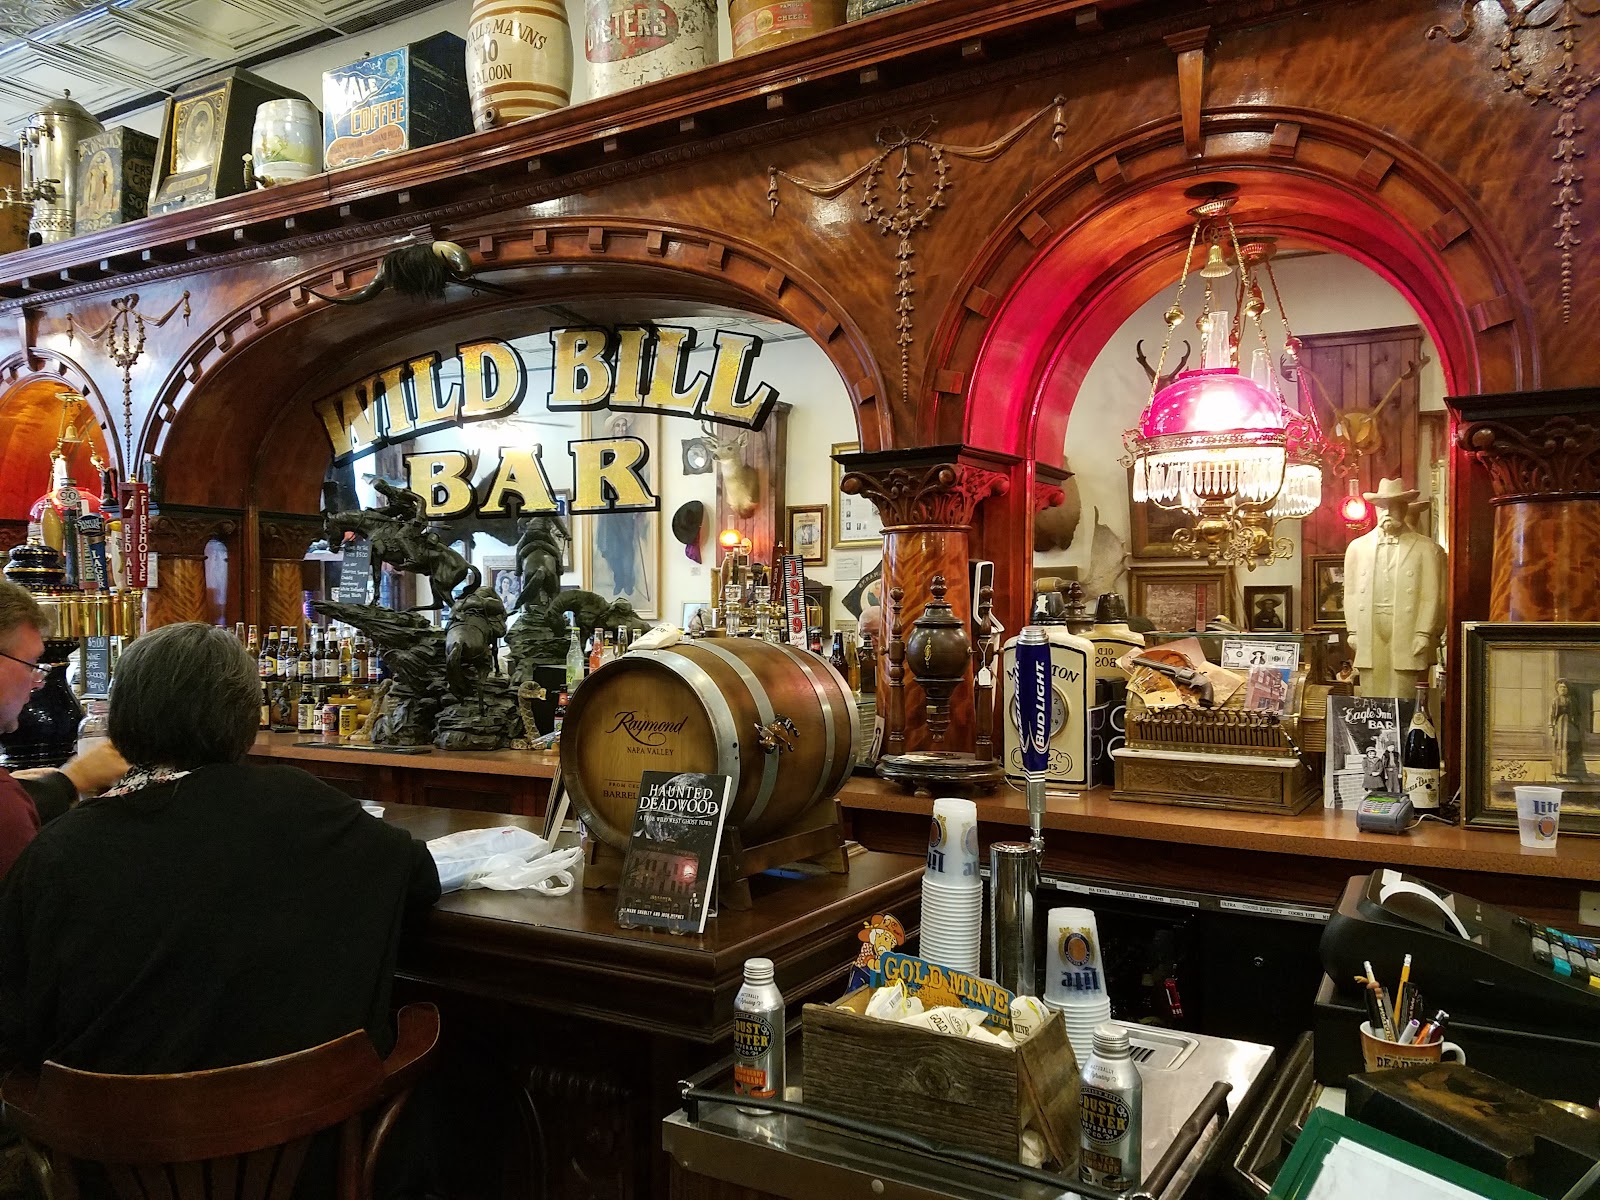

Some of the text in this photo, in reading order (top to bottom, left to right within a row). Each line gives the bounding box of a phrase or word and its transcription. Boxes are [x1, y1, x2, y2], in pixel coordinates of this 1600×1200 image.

[776, 13, 808, 22] CHEESE
[481, 38, 499, 65] 10
[471, 63, 512, 89] SALOON
[350, 96, 405, 136] COFFEE
[313, 325, 780, 467] WILD BILL
[402, 435, 662, 519] BAR
[60, 490, 77, 501] 90
[138, 495, 148, 582] FIREHOUSE
[124, 523, 133, 586] RED ALE
[91, 550, 106, 588] LAGER
[789, 560, 803, 634] 1919
[1051, 664, 1080, 684] TON
[1035, 660, 1045, 748] BUD LIGHT
[1375, 707, 1393, 720] Inn
[604, 710, 689, 747] Raymond
[1368, 719, 1396, 730] BAR
[626, 746, 675, 756] NAPA VALLEY
[602, 789, 638, 800] BARREL
[648, 783, 714, 801] HAUNTED
[639, 796, 720, 815] DEADWOOD
[1533, 800, 1559, 816] Lite
[669, 817, 681, 825] WEST
[681, 818, 698, 826] GHOST
[698, 819, 713, 827] TOWN
[926, 850, 946, 874] Lit
[884, 956, 1009, 1015] GOLD MINE
[1061, 966, 1100, 991] Lite
[735, 1019, 761, 1035] DUST
[929, 1013, 948, 1032] GOLD
[734, 1031, 768, 1047] UTTER
[1083, 1095, 1117, 1116] DUST
